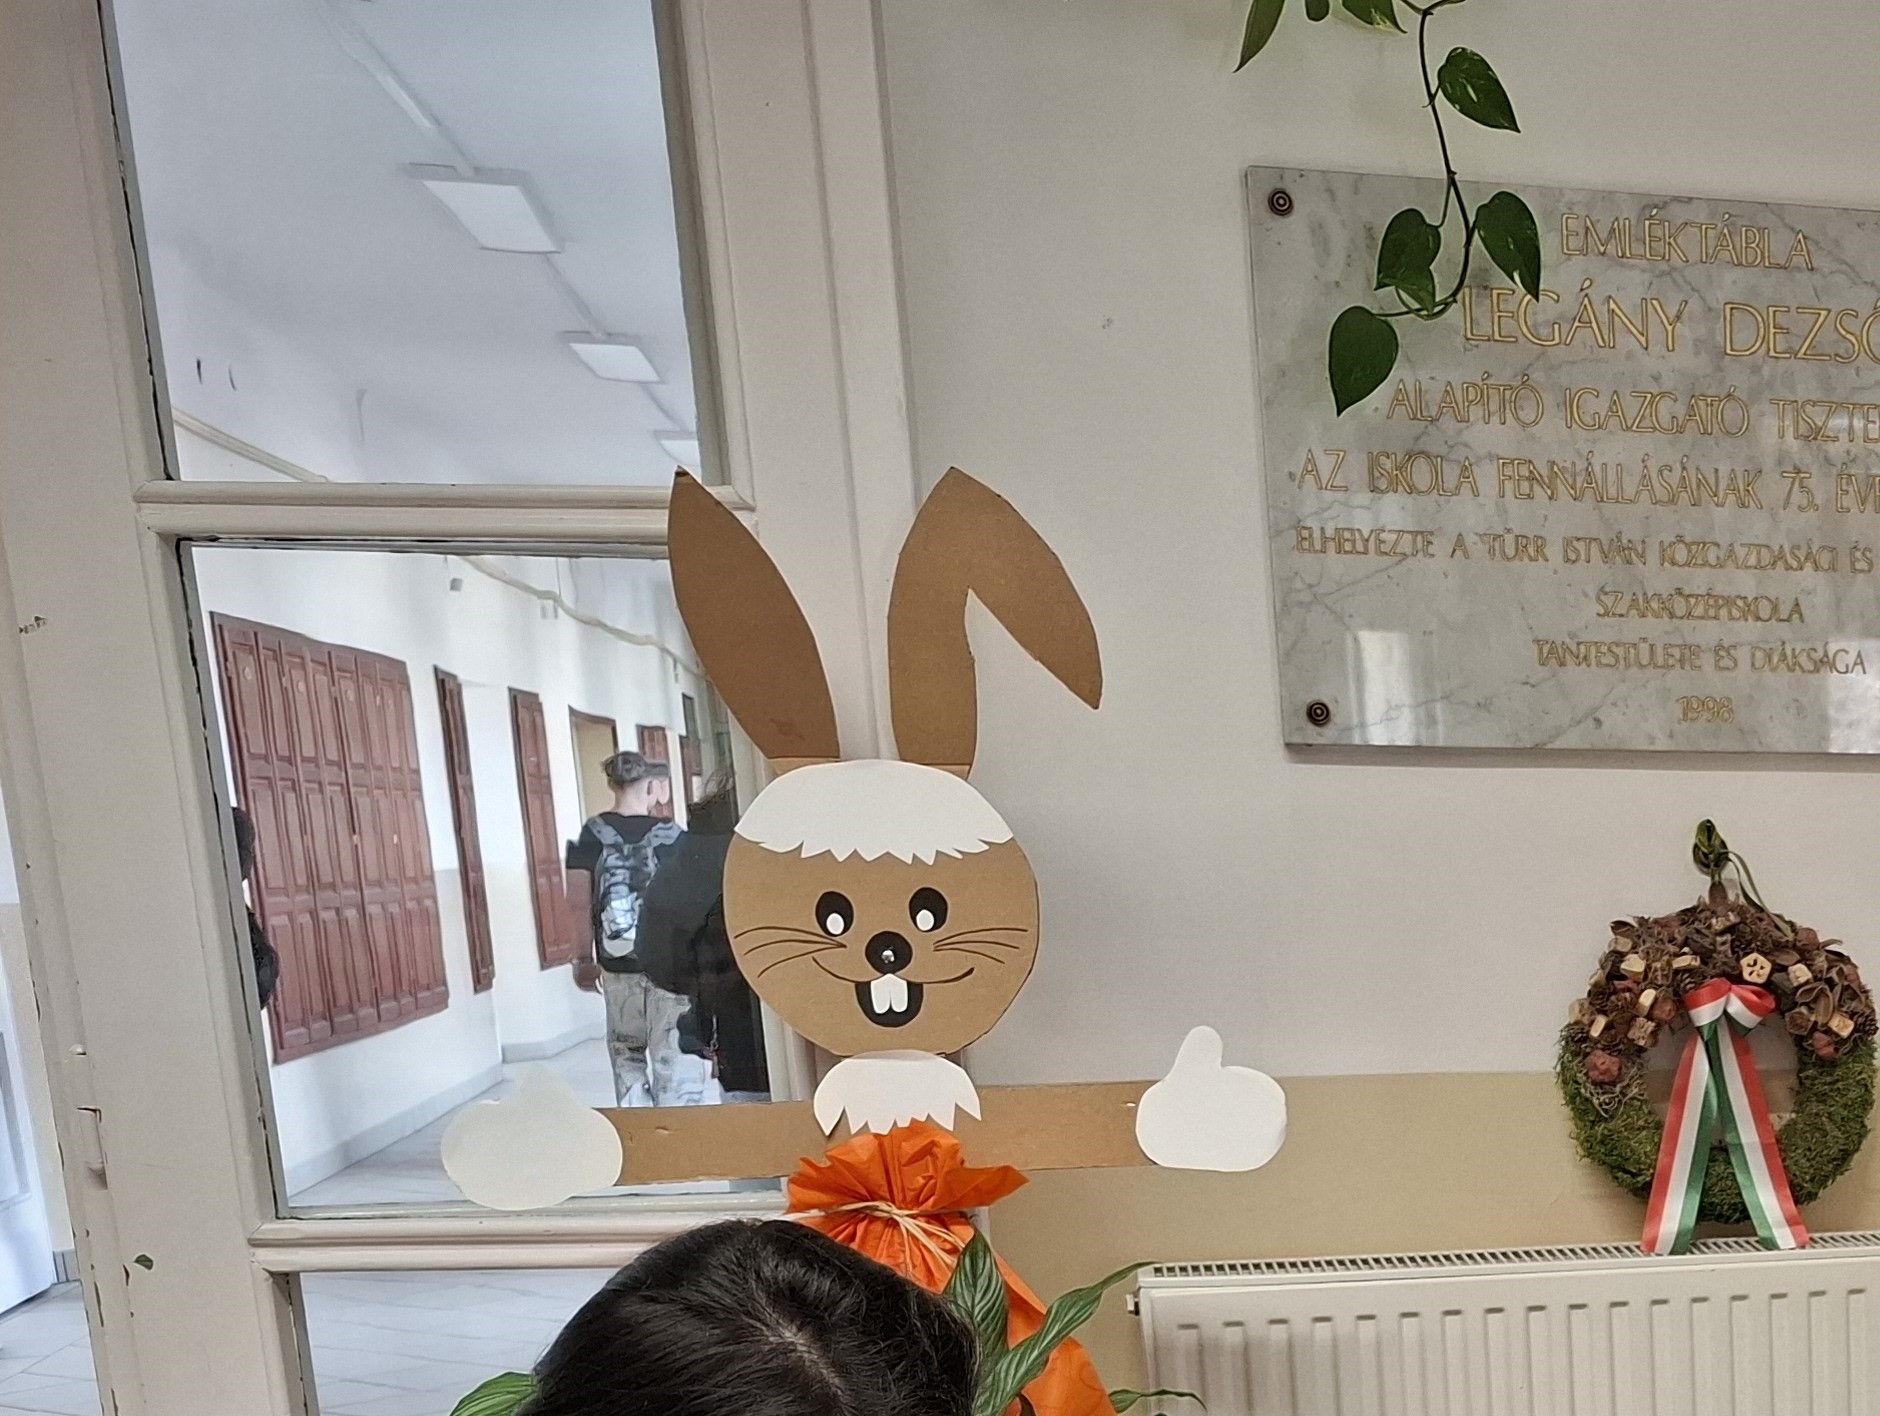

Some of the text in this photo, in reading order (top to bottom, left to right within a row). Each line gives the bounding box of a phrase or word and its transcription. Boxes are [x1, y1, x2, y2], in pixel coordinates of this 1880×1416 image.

[1561, 208, 1815, 272] EMLÉKTÁBLA
[1462, 278, 1688, 352] LEGÁNY
[1386, 371, 1545, 428] ALAPÍTÓ
[1563, 384, 1750, 438] IGAZGATÓ
[1298, 448, 1349, 492] AZ
[1366, 450, 1480, 497] ISKOLA
[1497, 451, 1764, 509] FENNÁLLÁSÁNAK
[1296, 525, 1436, 559] ELHELYEZTE
[1449, 531, 1471, 560] A
[1478, 527, 1549, 563] TÜRR
[1562, 530, 1647, 566] ISTVÁN
[1659, 535, 1839, 572] KÖZGAZDASÁGI
[1850, 540, 1875, 574] ÉS
[1595, 586, 1805, 624] SZAKKÖZÉPISKOLA
[1532, 636, 1868, 675] TANTESTÜLETE ÉS DIÁKSÁGA
[1675, 695, 1734, 723] 1998
